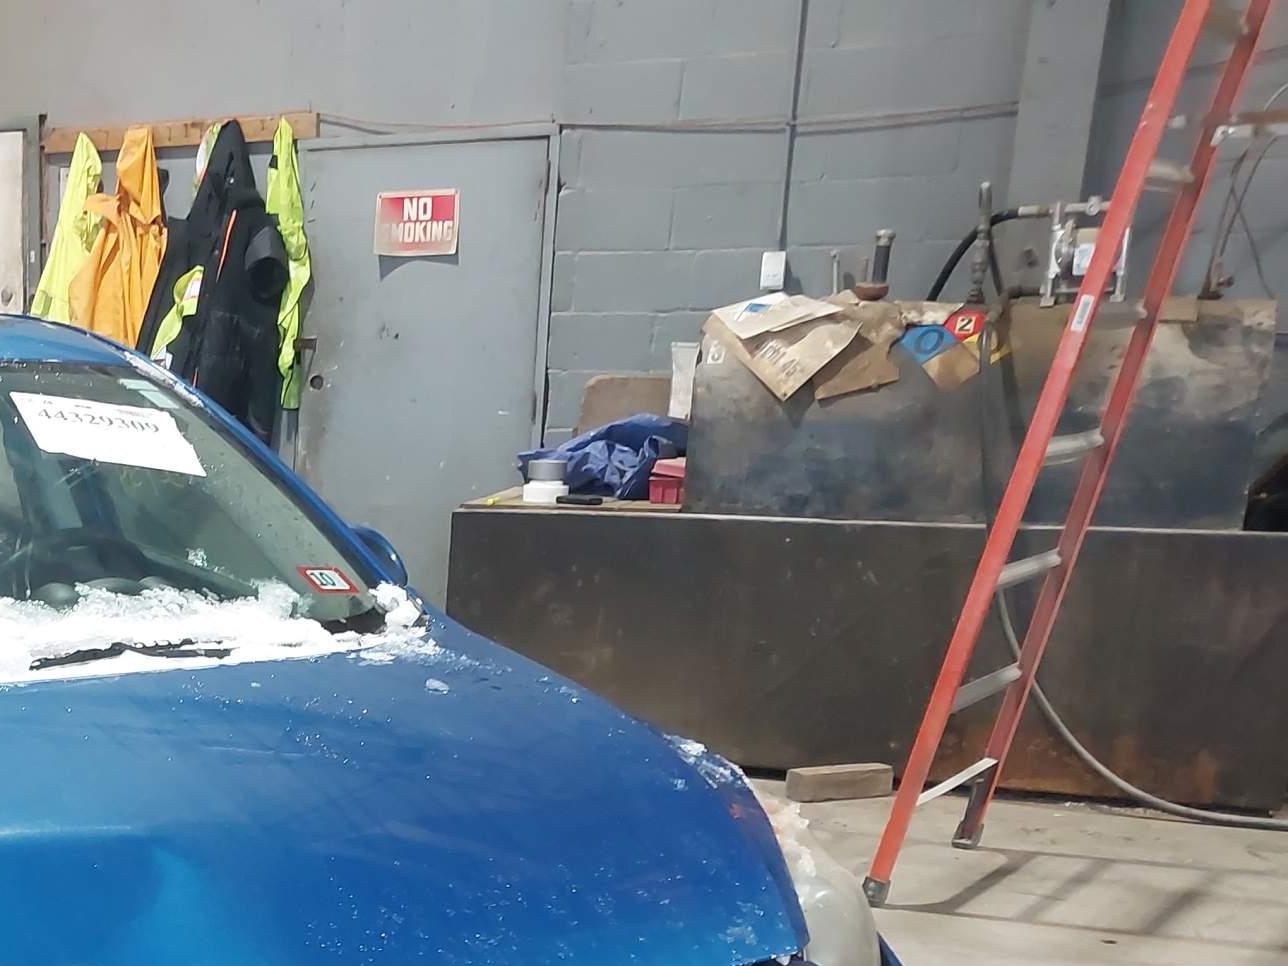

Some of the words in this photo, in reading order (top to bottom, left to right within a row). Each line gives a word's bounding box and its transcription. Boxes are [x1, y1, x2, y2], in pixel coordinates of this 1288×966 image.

[403, 196, 433, 221] NO
[378, 220, 453, 243] MOKING
[957, 317, 973, 332] 2
